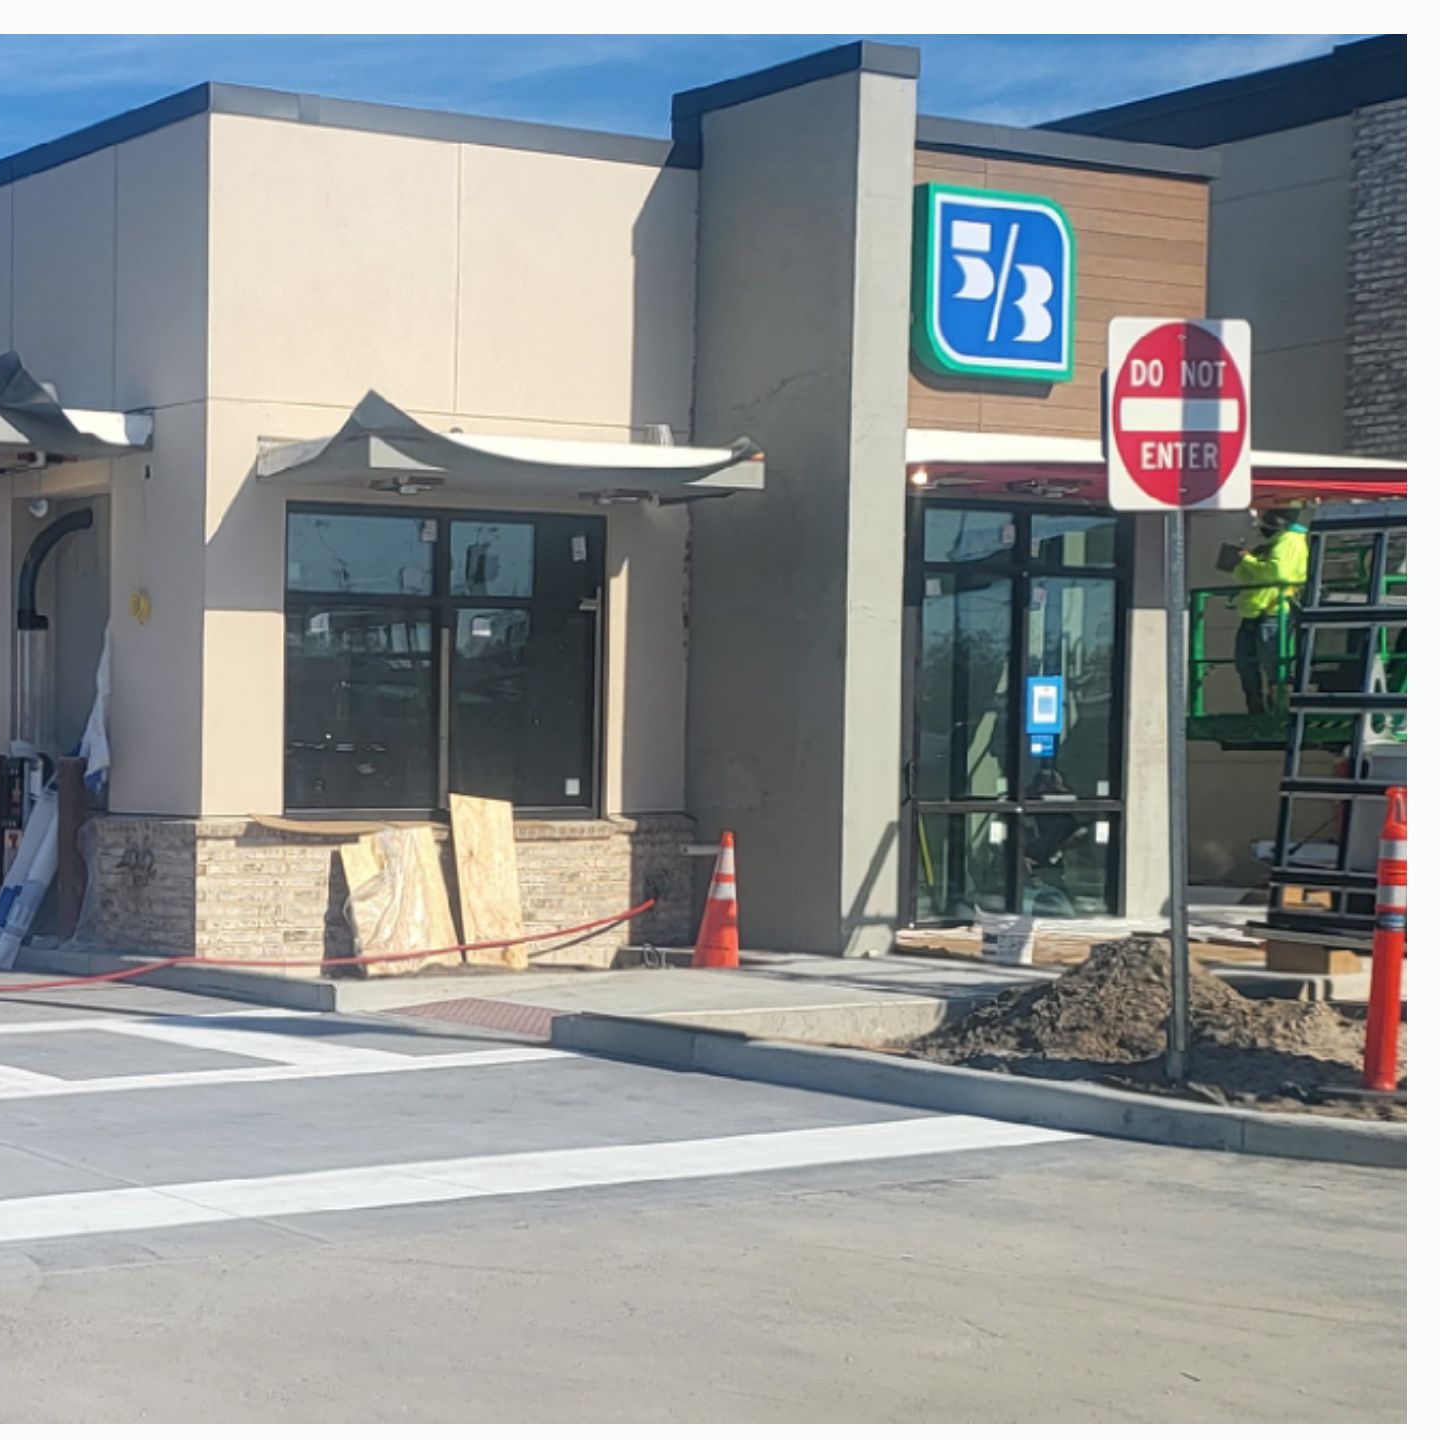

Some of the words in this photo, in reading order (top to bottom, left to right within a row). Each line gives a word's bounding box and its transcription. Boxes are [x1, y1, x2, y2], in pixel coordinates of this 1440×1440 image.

[1130, 358, 1164, 388] DO
[1180, 359, 1227, 389] NOT
[1140, 440, 1219, 470] ENTER
